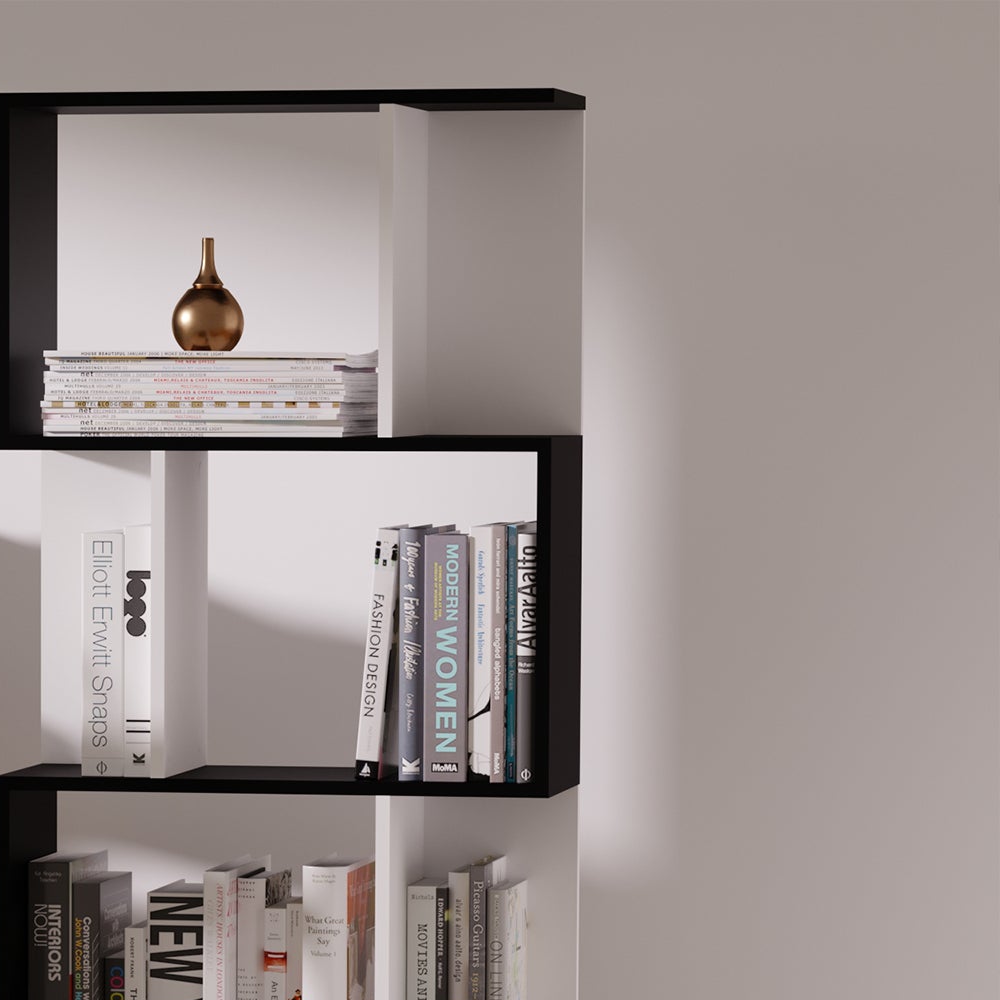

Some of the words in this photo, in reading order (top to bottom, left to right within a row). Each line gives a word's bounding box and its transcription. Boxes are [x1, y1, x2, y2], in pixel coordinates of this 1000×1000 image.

[91, 540, 113, 598] Elliott
[445, 544, 460, 621] MODERN
[91, 606, 113, 668] Erwitt
[369, 593, 385, 658] FASHION
[493, 627, 501, 659] tangled
[363, 663, 379, 718] DESIGN
[435, 626, 458, 753] WOMEN
[493, 660, 501, 701] alphabets
[88, 675, 113, 748] Snaps
[132, 752, 146, 764] K
[433, 763, 457, 773] MoMA
[304, 915, 323, 924] What
[473, 880, 484, 922] Picasso
[34, 903, 48, 947] NOW!
[48, 904, 61, 982] INTERIORS
[75, 917, 83, 938] John
[149, 896, 203, 985] NEW
[307, 926, 341, 937] Paintings
[317, 938, 329, 947] Say
[473, 924, 484, 968] Guitars
[82, 916, 92, 990] Conversations
[417, 923, 428, 976] MOVIES
[490, 940, 504, 963] ON
[75, 973, 83, 990] and
[271, 981, 279, 993] An
